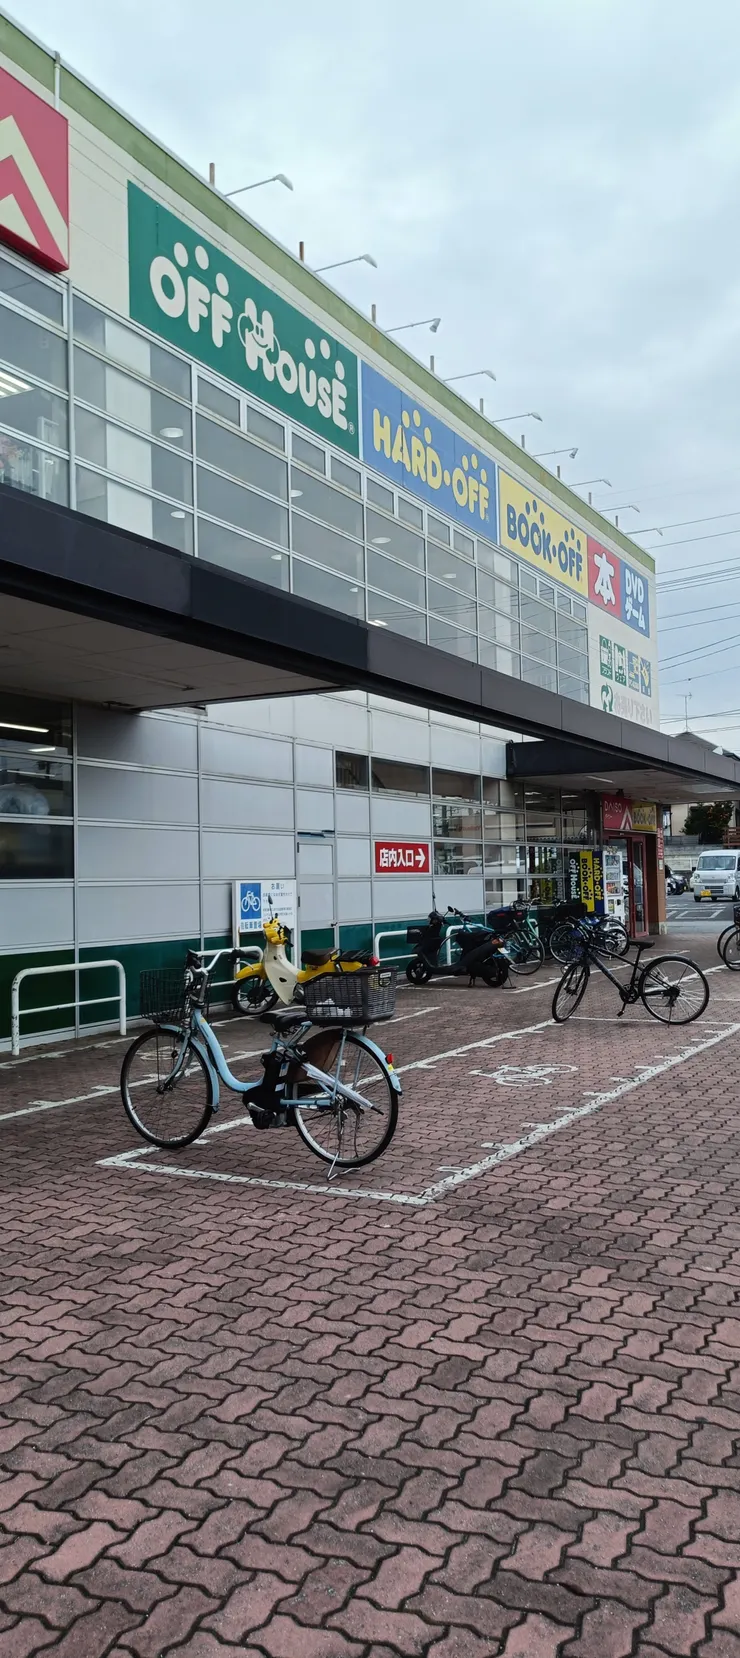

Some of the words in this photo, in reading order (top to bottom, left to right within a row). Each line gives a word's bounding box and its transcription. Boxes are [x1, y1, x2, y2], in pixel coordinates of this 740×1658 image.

[150, 248, 233, 347] OFF
[238, 298, 348, 430] HOUSE
[593, 552, 616, 606] 本
[625, 568, 644, 603] DVD
[624, 600, 646, 630] ゲーム
[604, 800, 622, 813] DAISO
[379, 848, 414, 868] 店内入口
